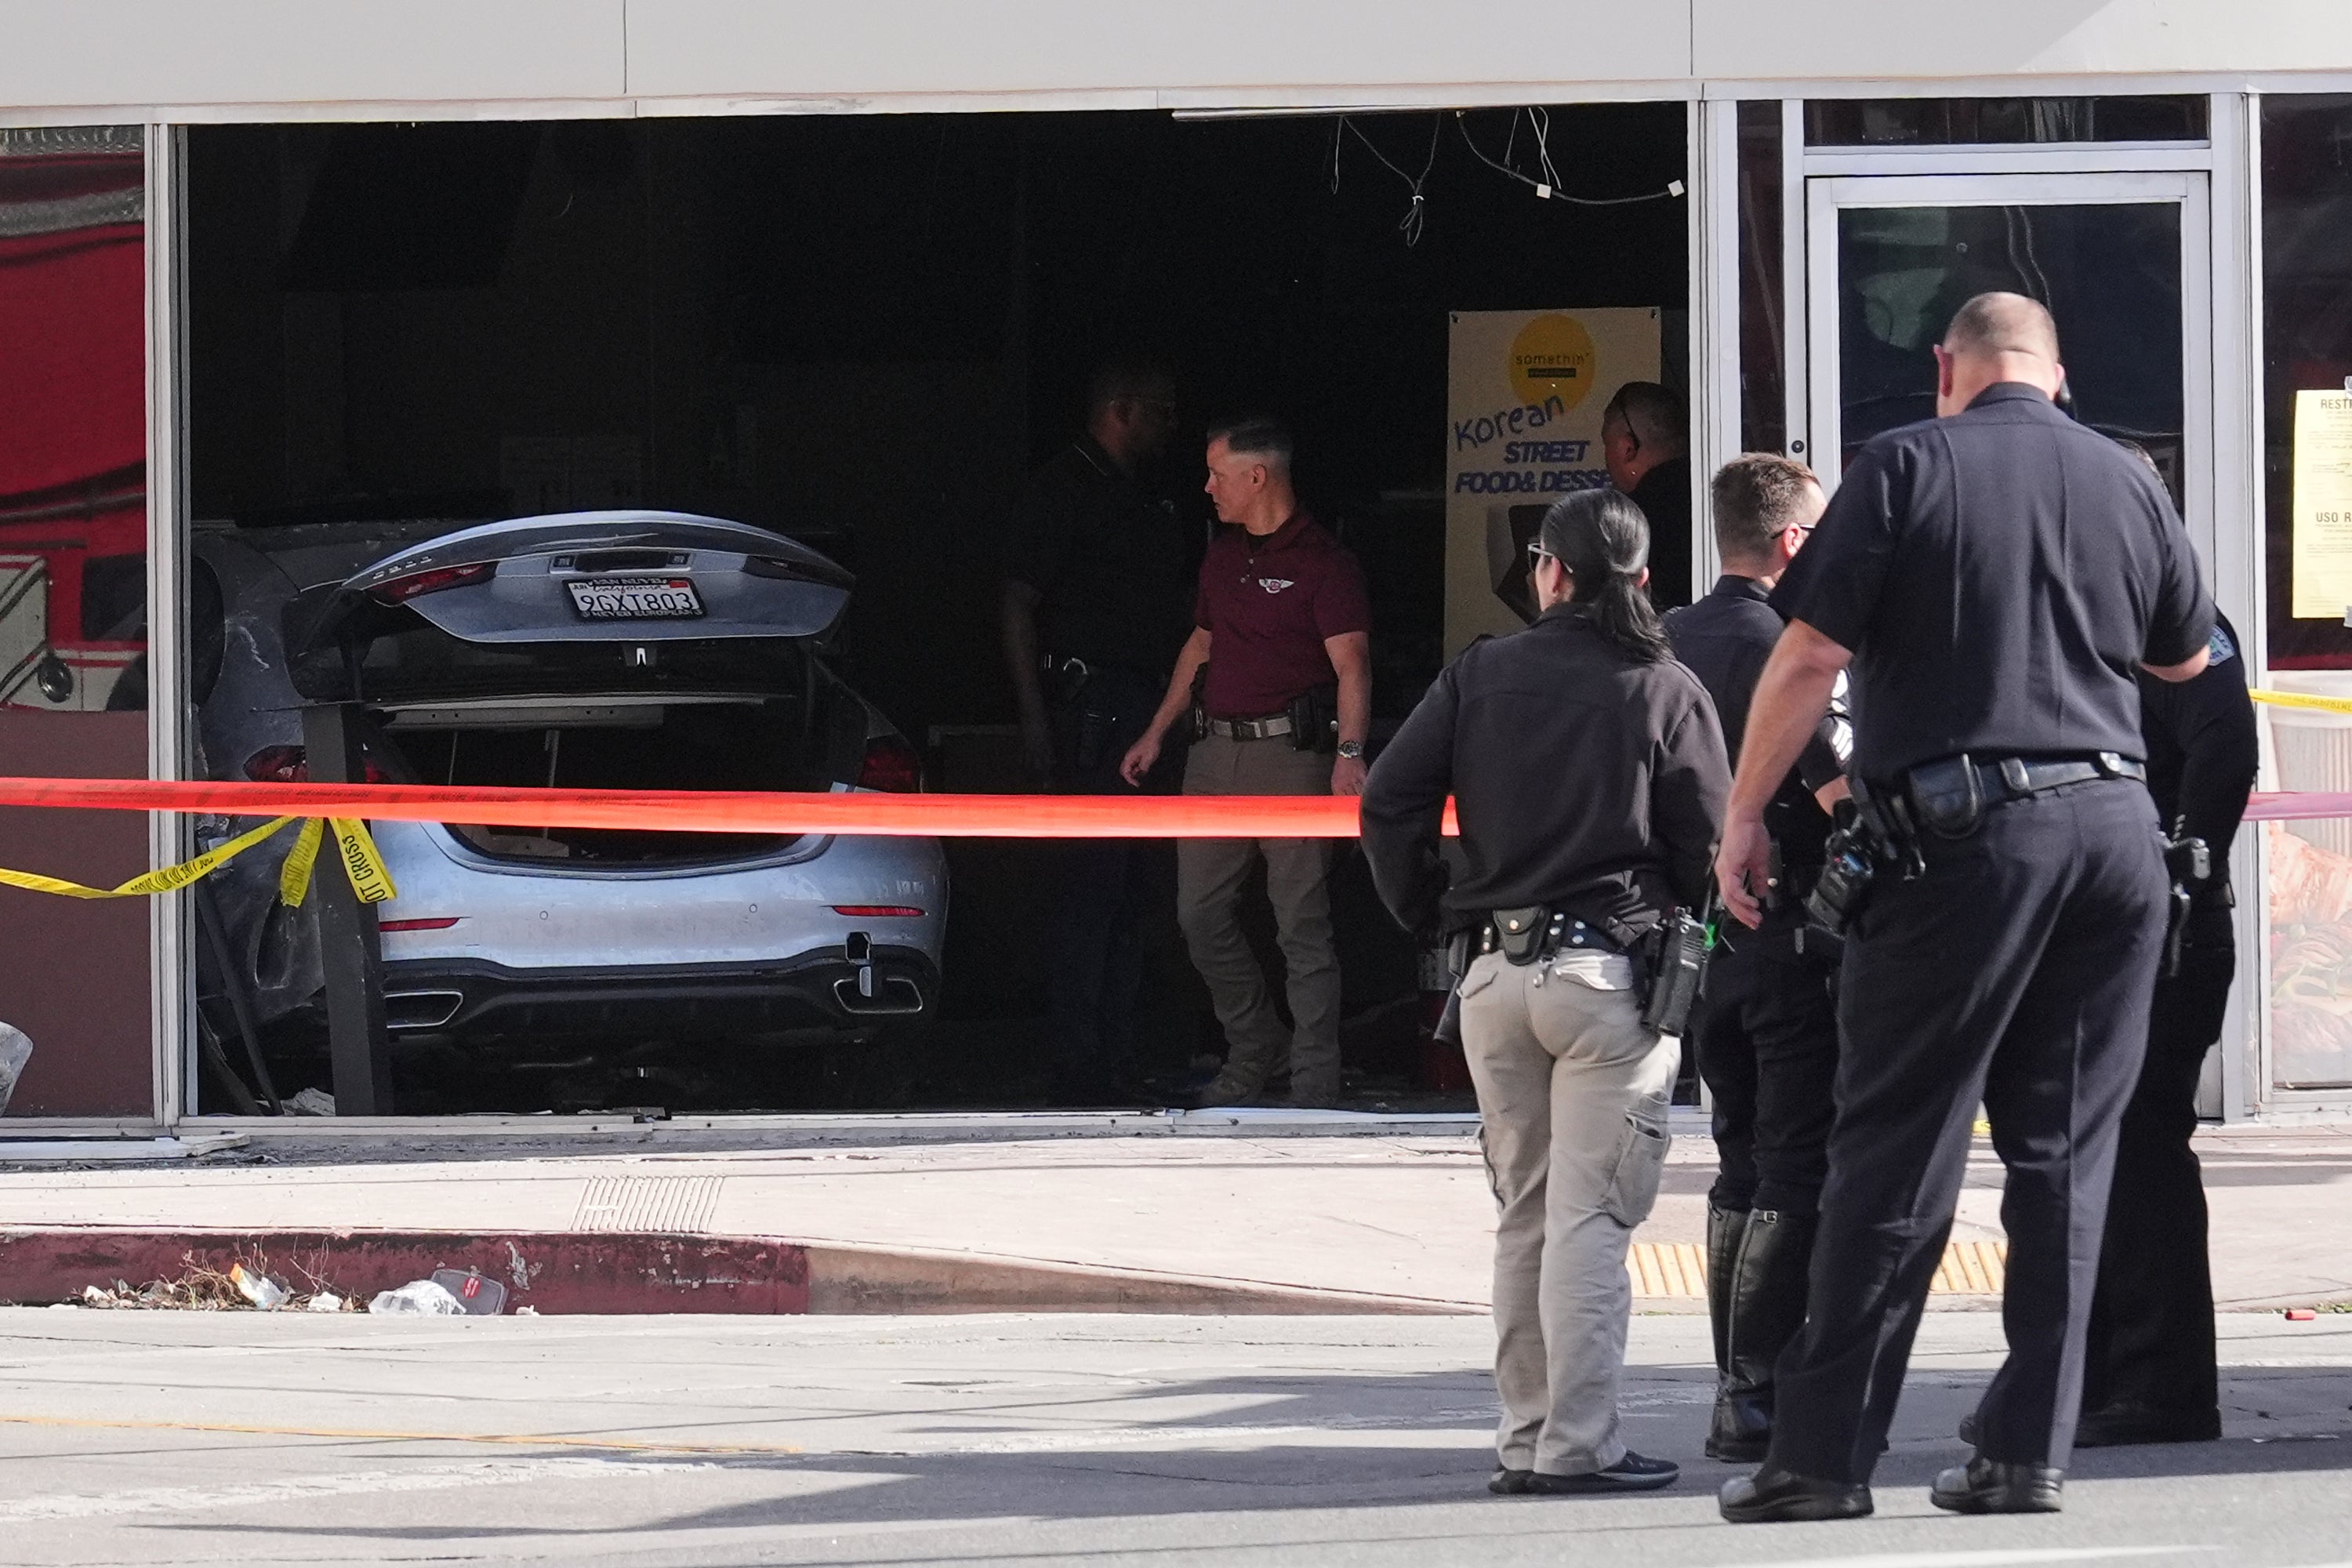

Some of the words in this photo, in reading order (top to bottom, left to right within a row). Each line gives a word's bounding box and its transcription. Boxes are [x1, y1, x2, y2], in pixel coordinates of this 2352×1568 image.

[1504, 440, 1591, 464] STREET
[2316, 511, 2339, 523] USO
[580, 592, 694, 612] 9GXT803
[342, 835, 374, 881] CROSS
